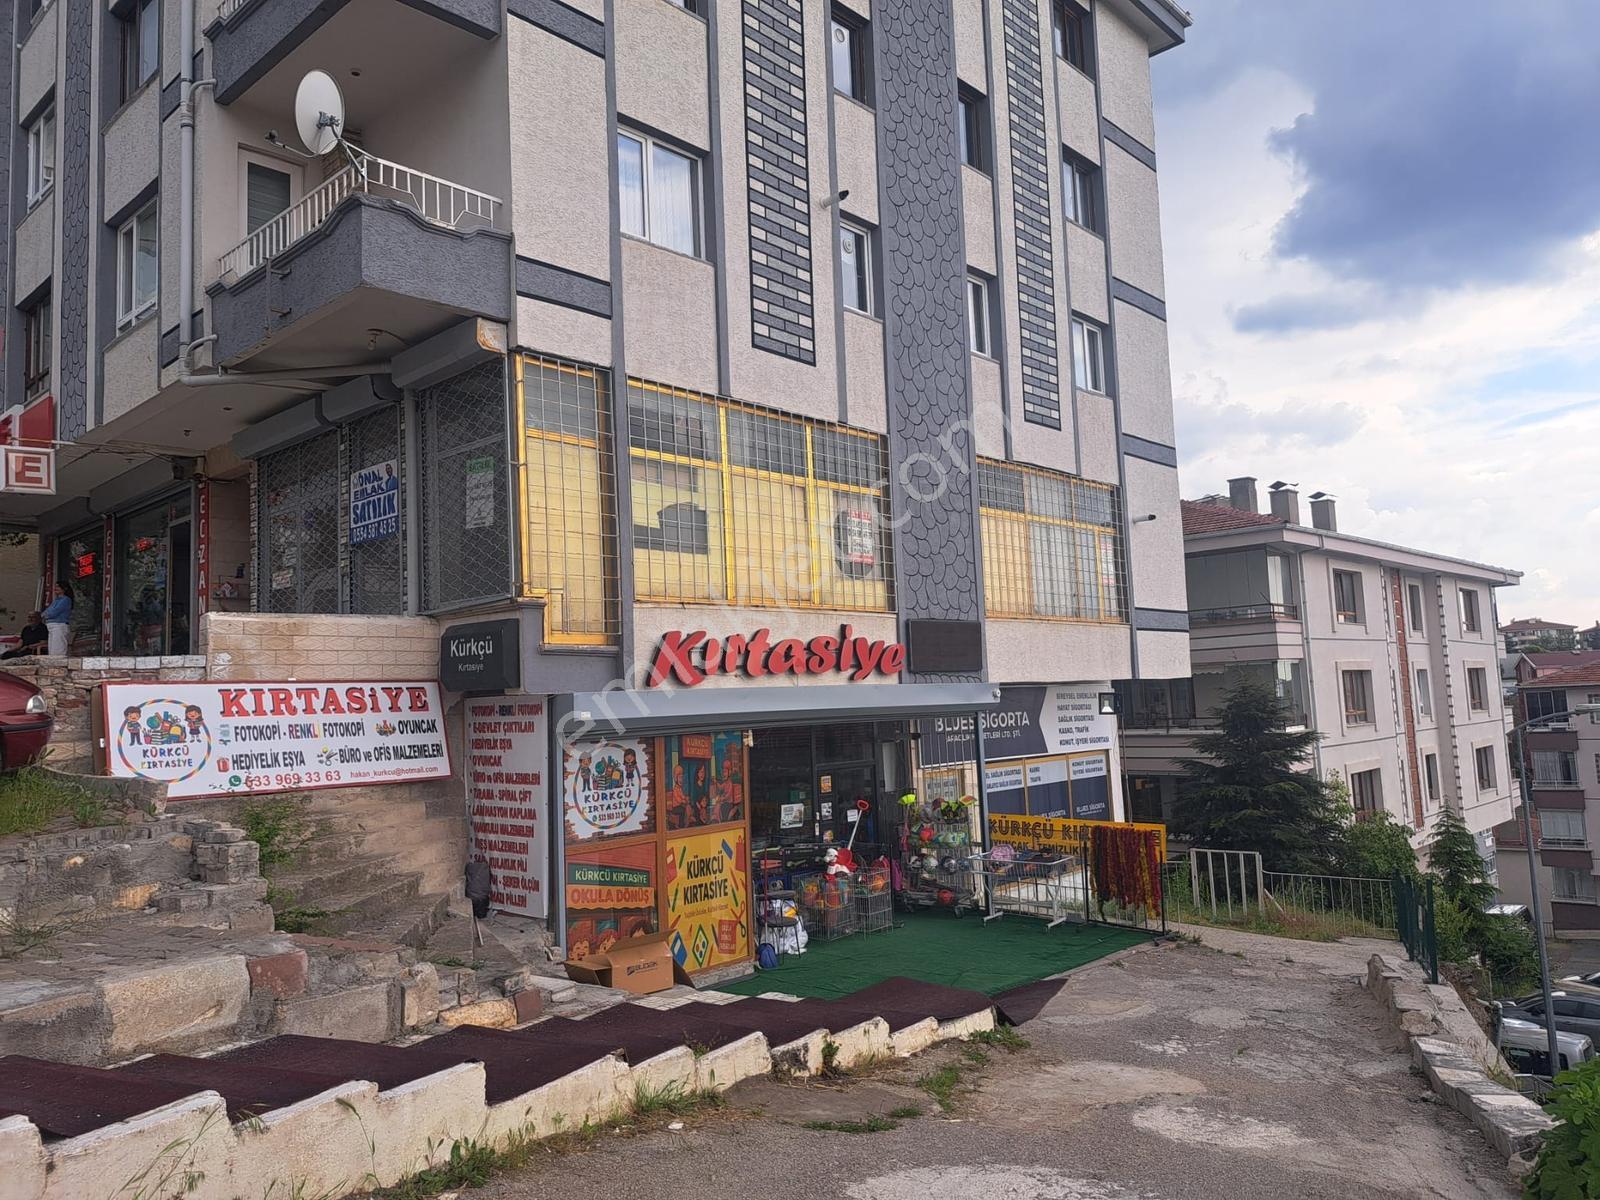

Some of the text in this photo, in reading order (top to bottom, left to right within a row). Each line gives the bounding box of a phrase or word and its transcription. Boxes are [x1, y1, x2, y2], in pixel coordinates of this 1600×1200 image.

[15, 456, 43, 484] E
[352, 493, 396, 525] SATILIK
[450, 635, 493, 660] Kürkçü
[647, 624, 906, 688] Kırtasiye
[234, 718, 439, 742] FOTOKOPİ RENKLİ FOTOKOPİ OYUNCAK
[473, 721, 535, 736] E-DEVLET ÇIKTILARI
[980, 710, 1030, 729] SİGORTA
[231, 740, 445, 771] HEDİYELİK EŞYA BÜRO ve OFİS MALZEMELERİ
[472, 755, 503, 767] OYUNCAK
[275, 772, 301, 786] 969
[305, 771, 321, 783] 33
[325, 770, 342, 782] 63
[488, 839, 529, 856] MALZEMELERİ
[612, 870, 648, 885] KIRTASİYE
[571, 887, 650, 905] OKULA DÖNÜŞ
[683, 876, 729, 906] KIRTASİYE
